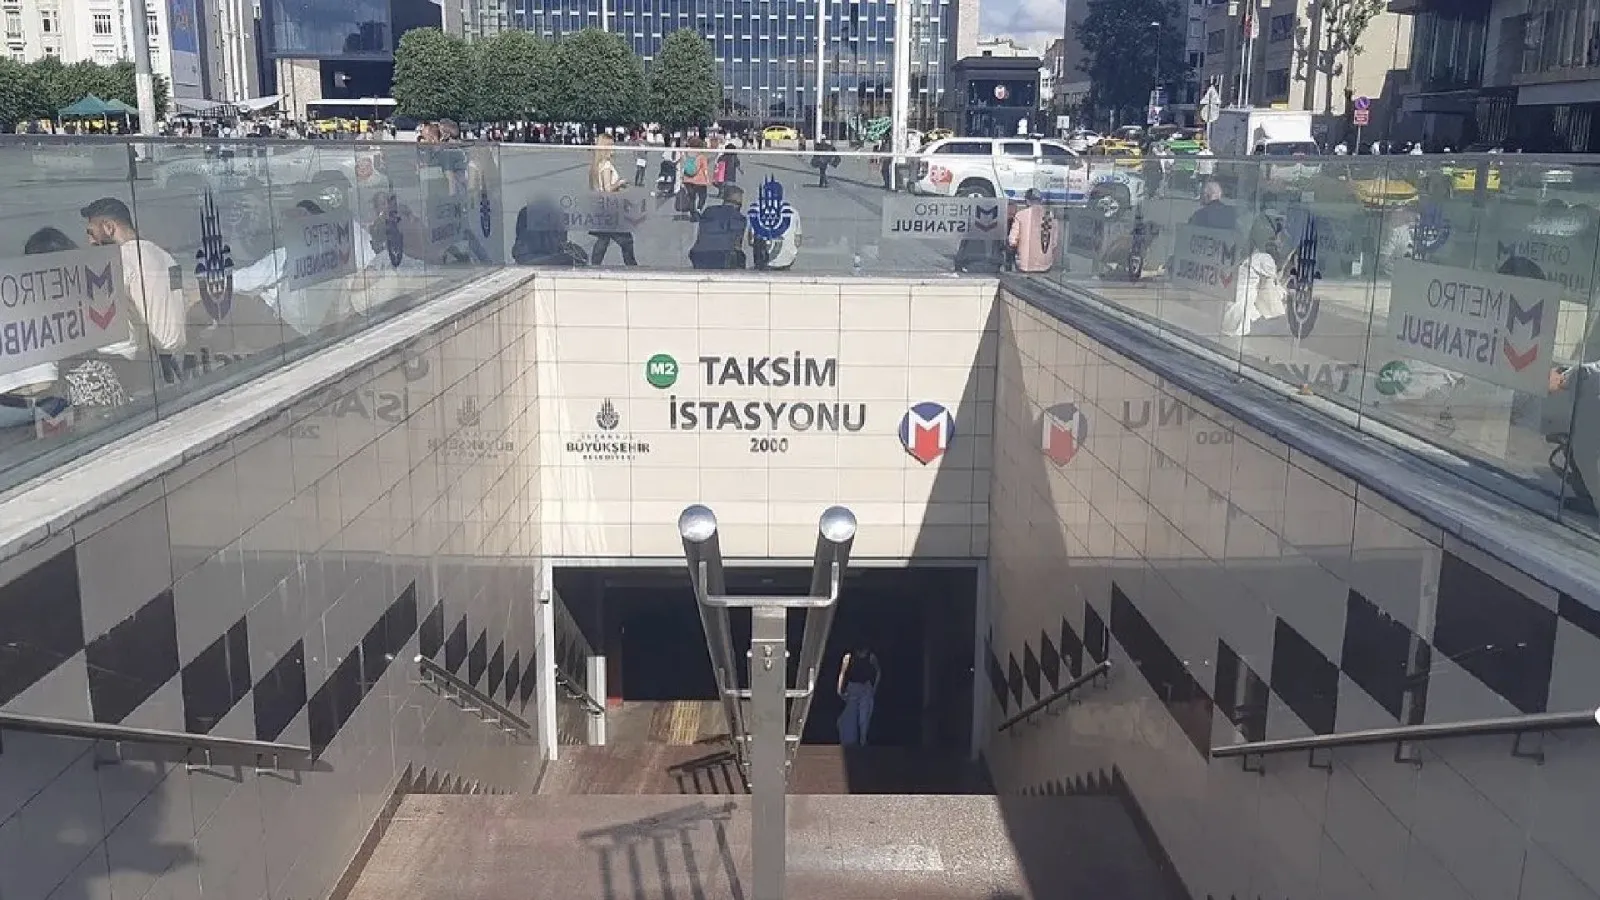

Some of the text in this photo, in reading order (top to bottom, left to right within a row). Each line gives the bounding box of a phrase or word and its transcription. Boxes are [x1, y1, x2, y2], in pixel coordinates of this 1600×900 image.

[650, 362, 676, 376] M2
[699, 351, 837, 387] TAKSİM
[669, 395, 867, 432] İSTASYONU
[750, 437, 790, 453] 2000
